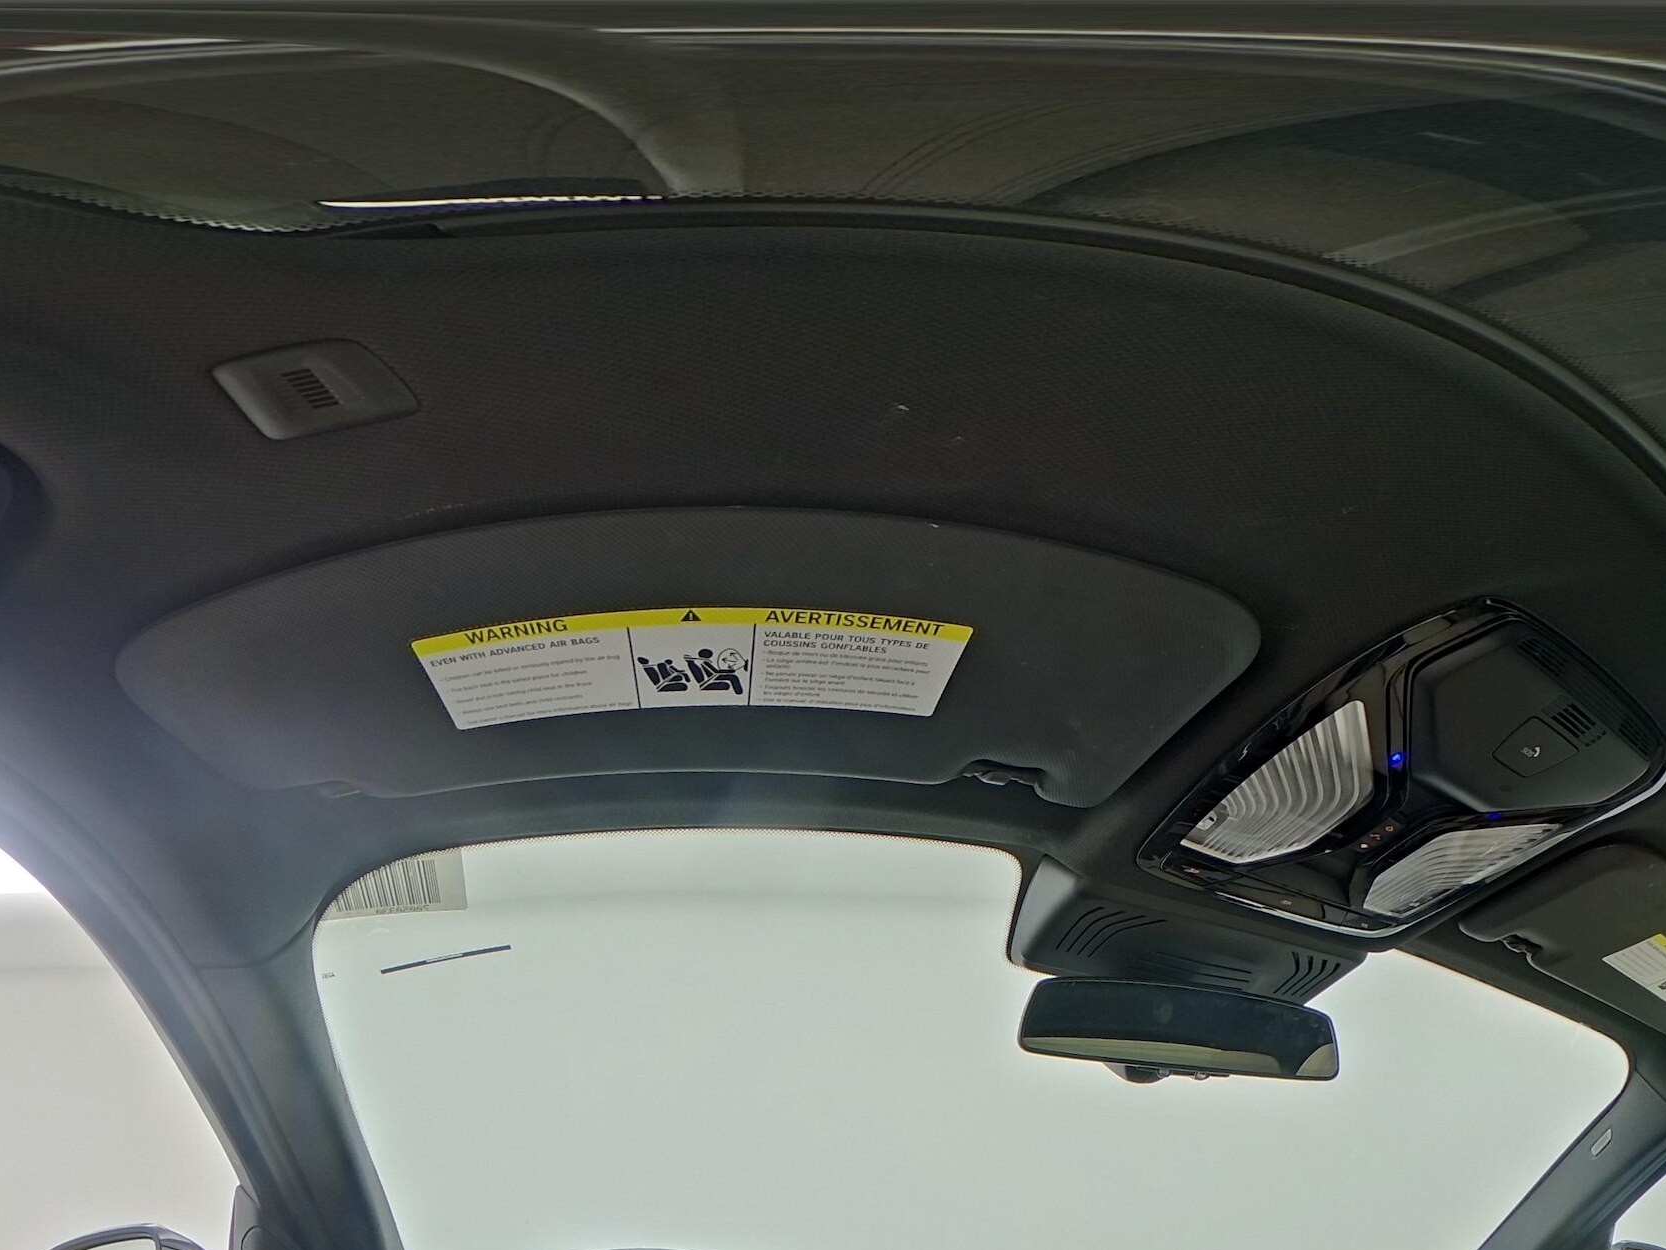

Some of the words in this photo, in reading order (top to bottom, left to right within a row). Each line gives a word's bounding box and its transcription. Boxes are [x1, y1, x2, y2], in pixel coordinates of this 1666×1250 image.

[464, 619, 568, 645] WARNING
[765, 610, 944, 636] AVERTISSEMENT
[430, 656, 457, 667] EVEN
[459, 651, 486, 662] WITH
[489, 643, 545, 657] ADVANCED
[550, 639, 567, 649] AIR
[571, 636, 600, 646] BAGS
[763, 639, 817, 649] COUSSINS
[821, 641, 887, 654] GONFLABLES
[764, 631, 810, 640] VALABLE
[815, 633, 844, 642] POUR
[848, 635, 876, 645] TOUS
[881, 638, 912, 648] TYPES
[915, 642, 930, 650] DE
